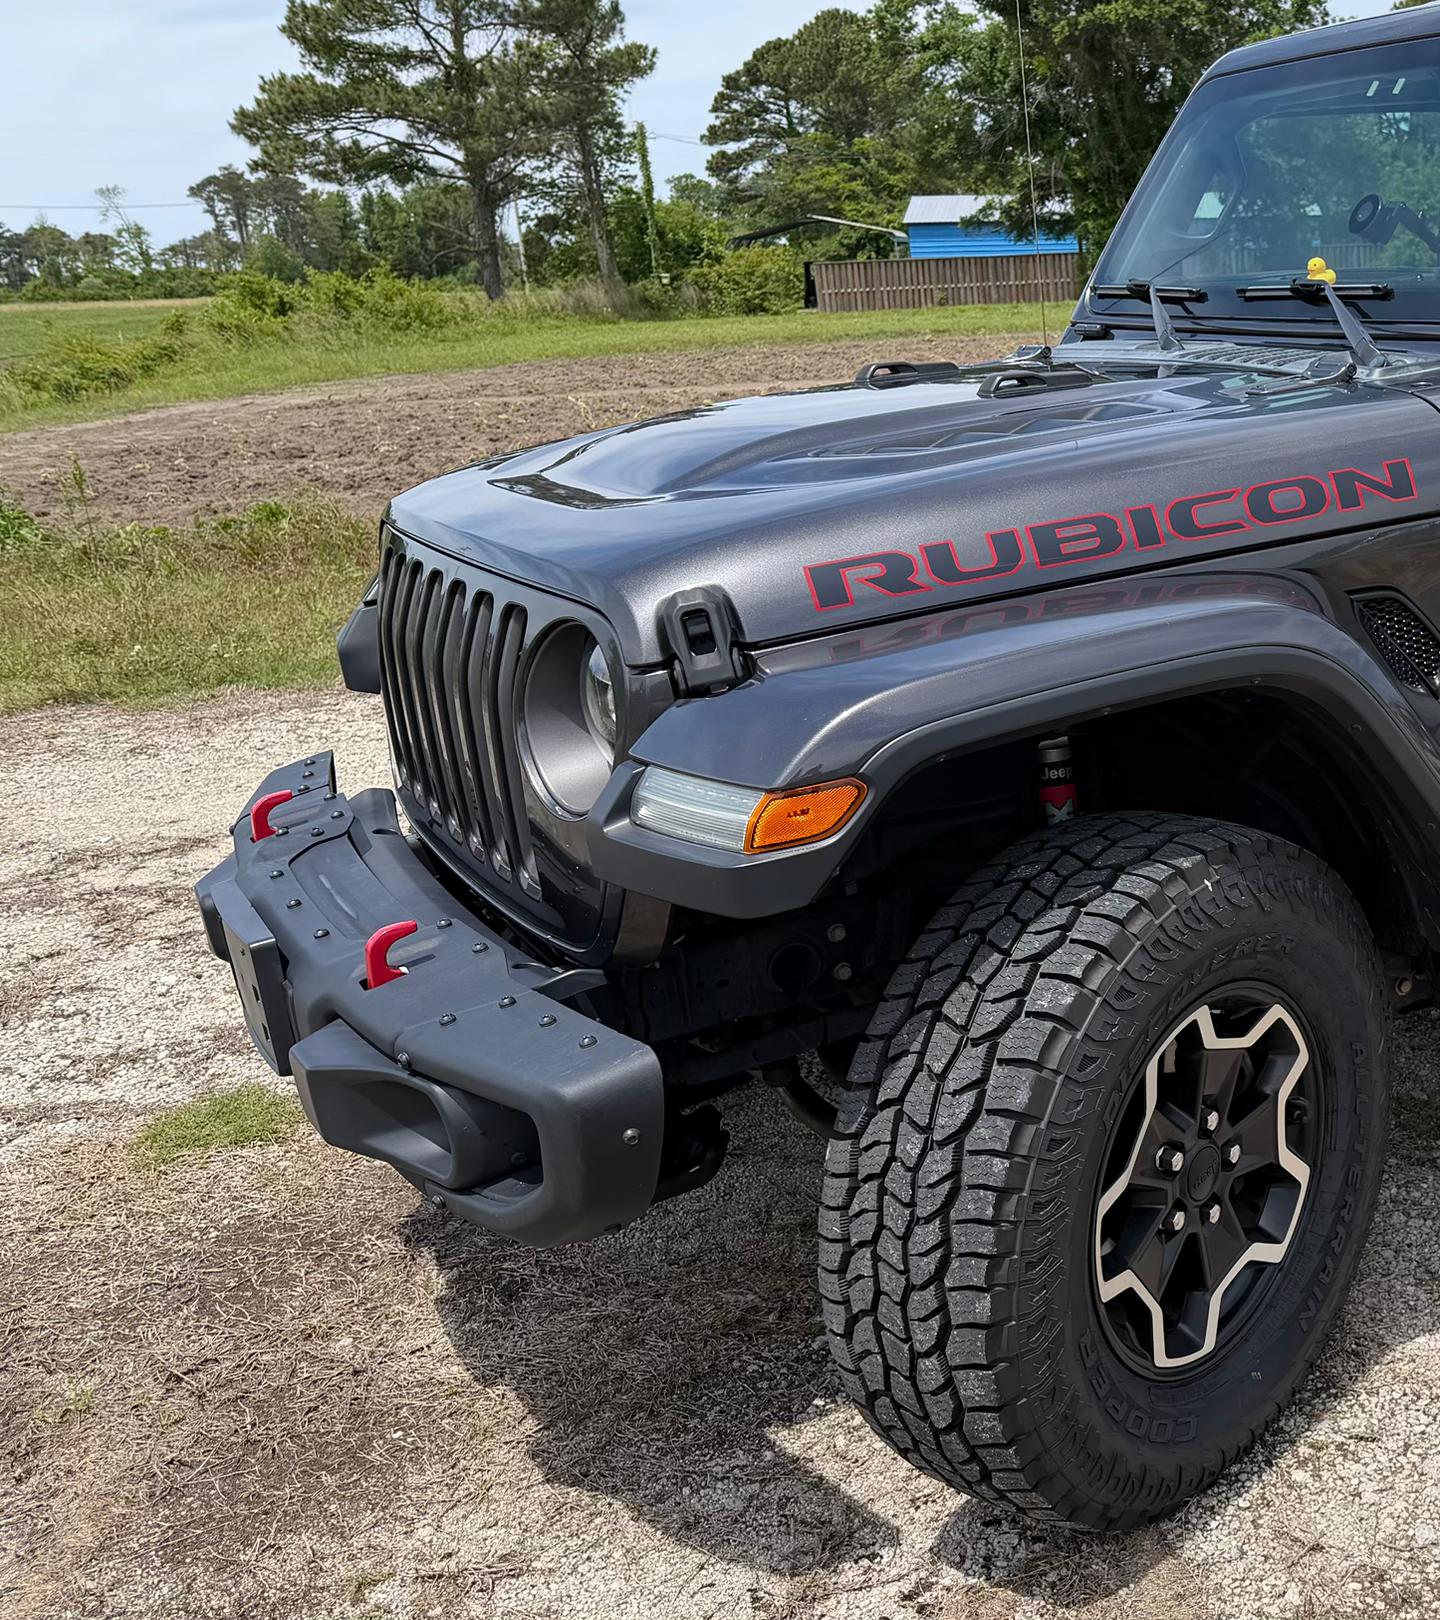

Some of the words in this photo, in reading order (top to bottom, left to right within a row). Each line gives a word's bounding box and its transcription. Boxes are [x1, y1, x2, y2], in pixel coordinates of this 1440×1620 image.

[803, 458, 1418, 612] RUBICON
[1041, 766, 1072, 779] Jeep
[1078, 1328, 1200, 1444] COOPER
